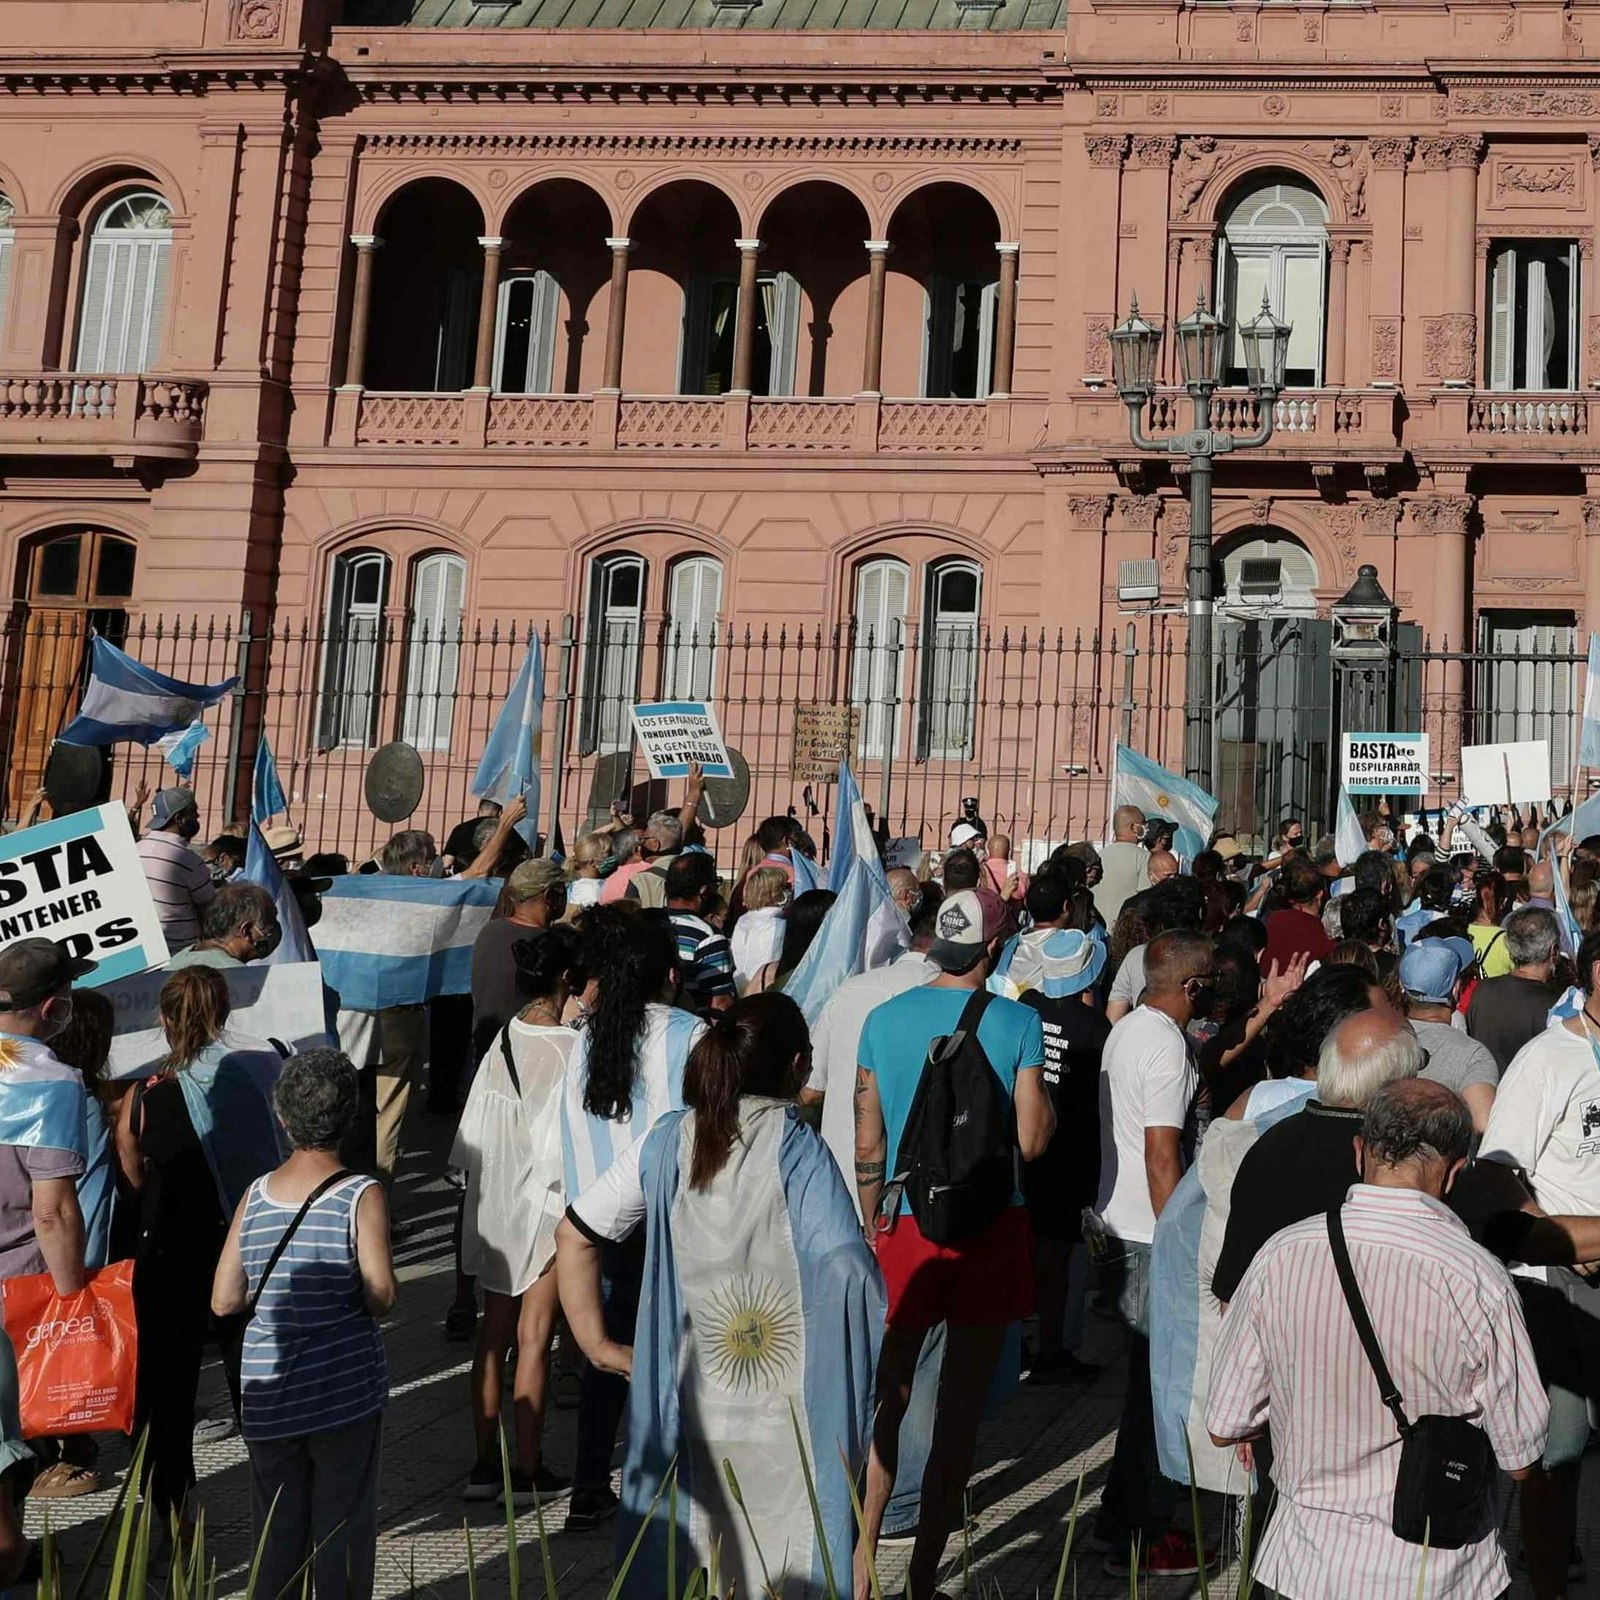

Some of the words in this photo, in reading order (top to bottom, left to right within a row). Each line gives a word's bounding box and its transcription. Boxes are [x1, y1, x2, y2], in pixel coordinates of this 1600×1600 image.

[637, 718, 657, 728] LOS
[659, 715, 710, 727] FERNANDEZ
[648, 743, 662, 752] LA
[664, 741, 698, 752] GENTE
[1350, 743, 1396, 759] BASTA
[1396, 748, 1415, 756] de
[653, 752, 675, 765] SIN
[675, 751, 724, 764] TRABAJO
[1349, 762, 1421, 772] DESPILFARRAR
[1349, 776, 1389, 785] nuestra
[1391, 776, 1421, 785] PLATA
[0, 889, 102, 942] NTENER
[26, 1316, 96, 1349] genea
